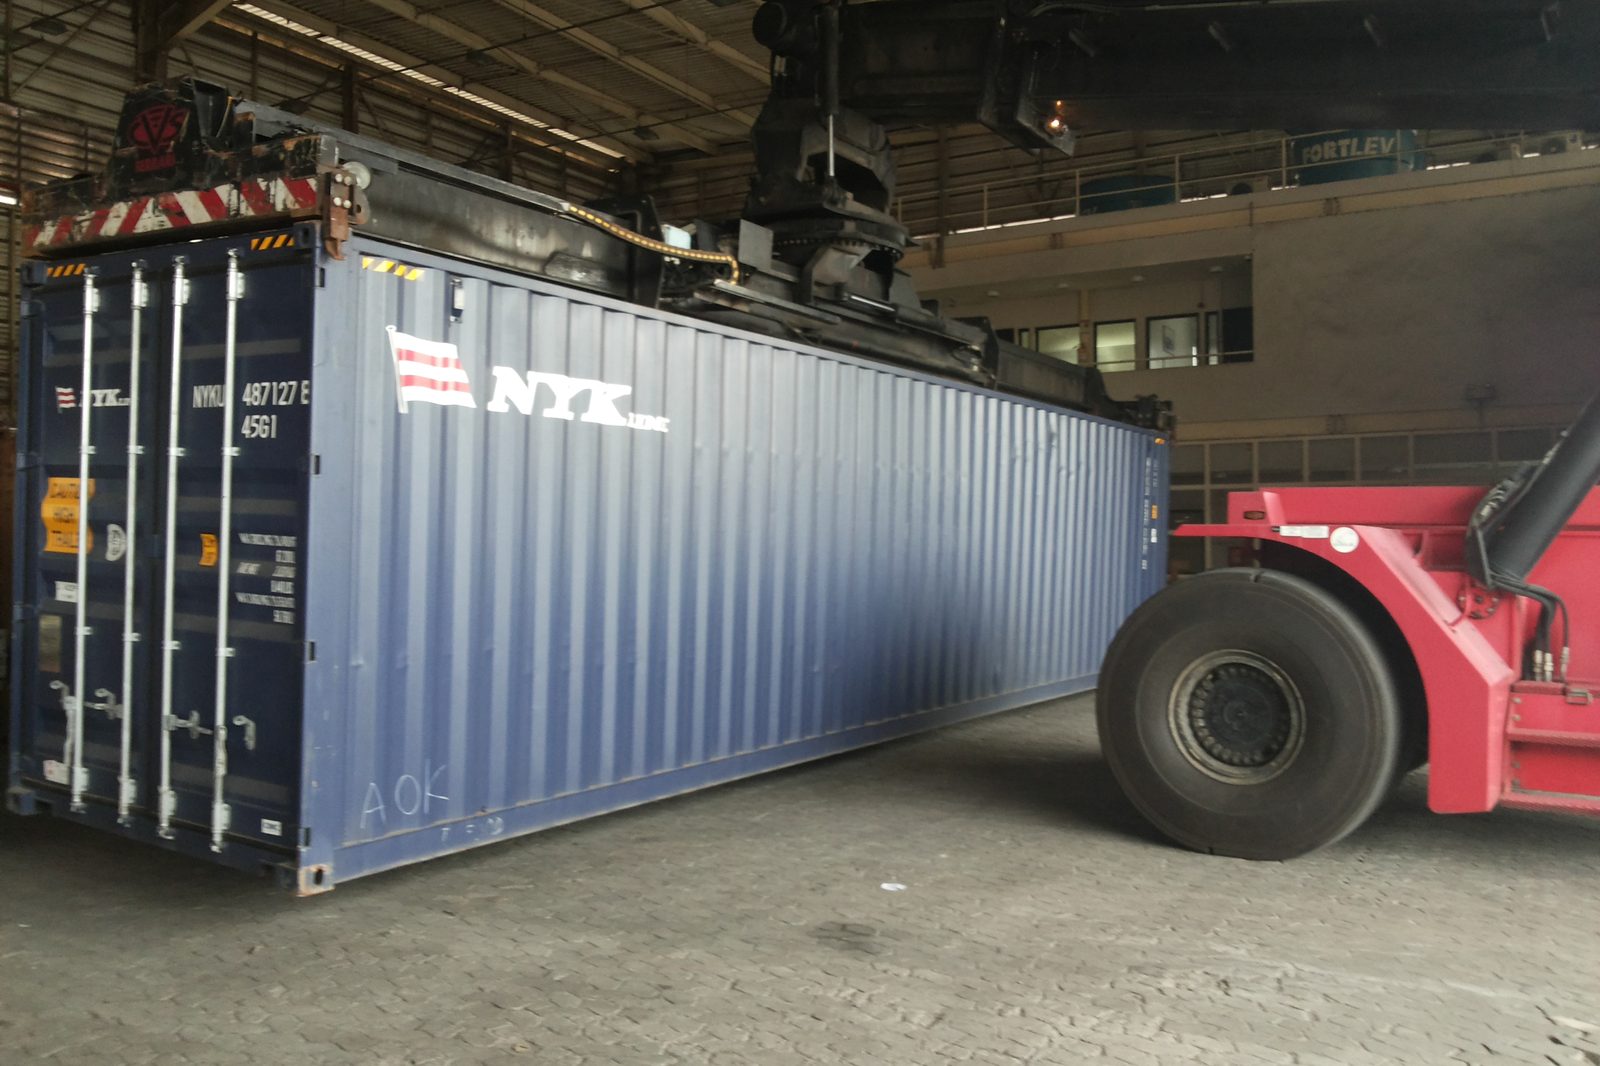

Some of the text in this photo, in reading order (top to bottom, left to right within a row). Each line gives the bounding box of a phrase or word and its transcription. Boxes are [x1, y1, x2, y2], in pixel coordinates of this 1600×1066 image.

[1303, 136, 1395, 164] FORTLEV
[79, 388, 122, 407] YK
[193, 384, 226, 408] NYKU
[242, 381, 298, 406] 487127
[487, 366, 632, 426] NYK
[241, 415, 278, 438] 45G1
